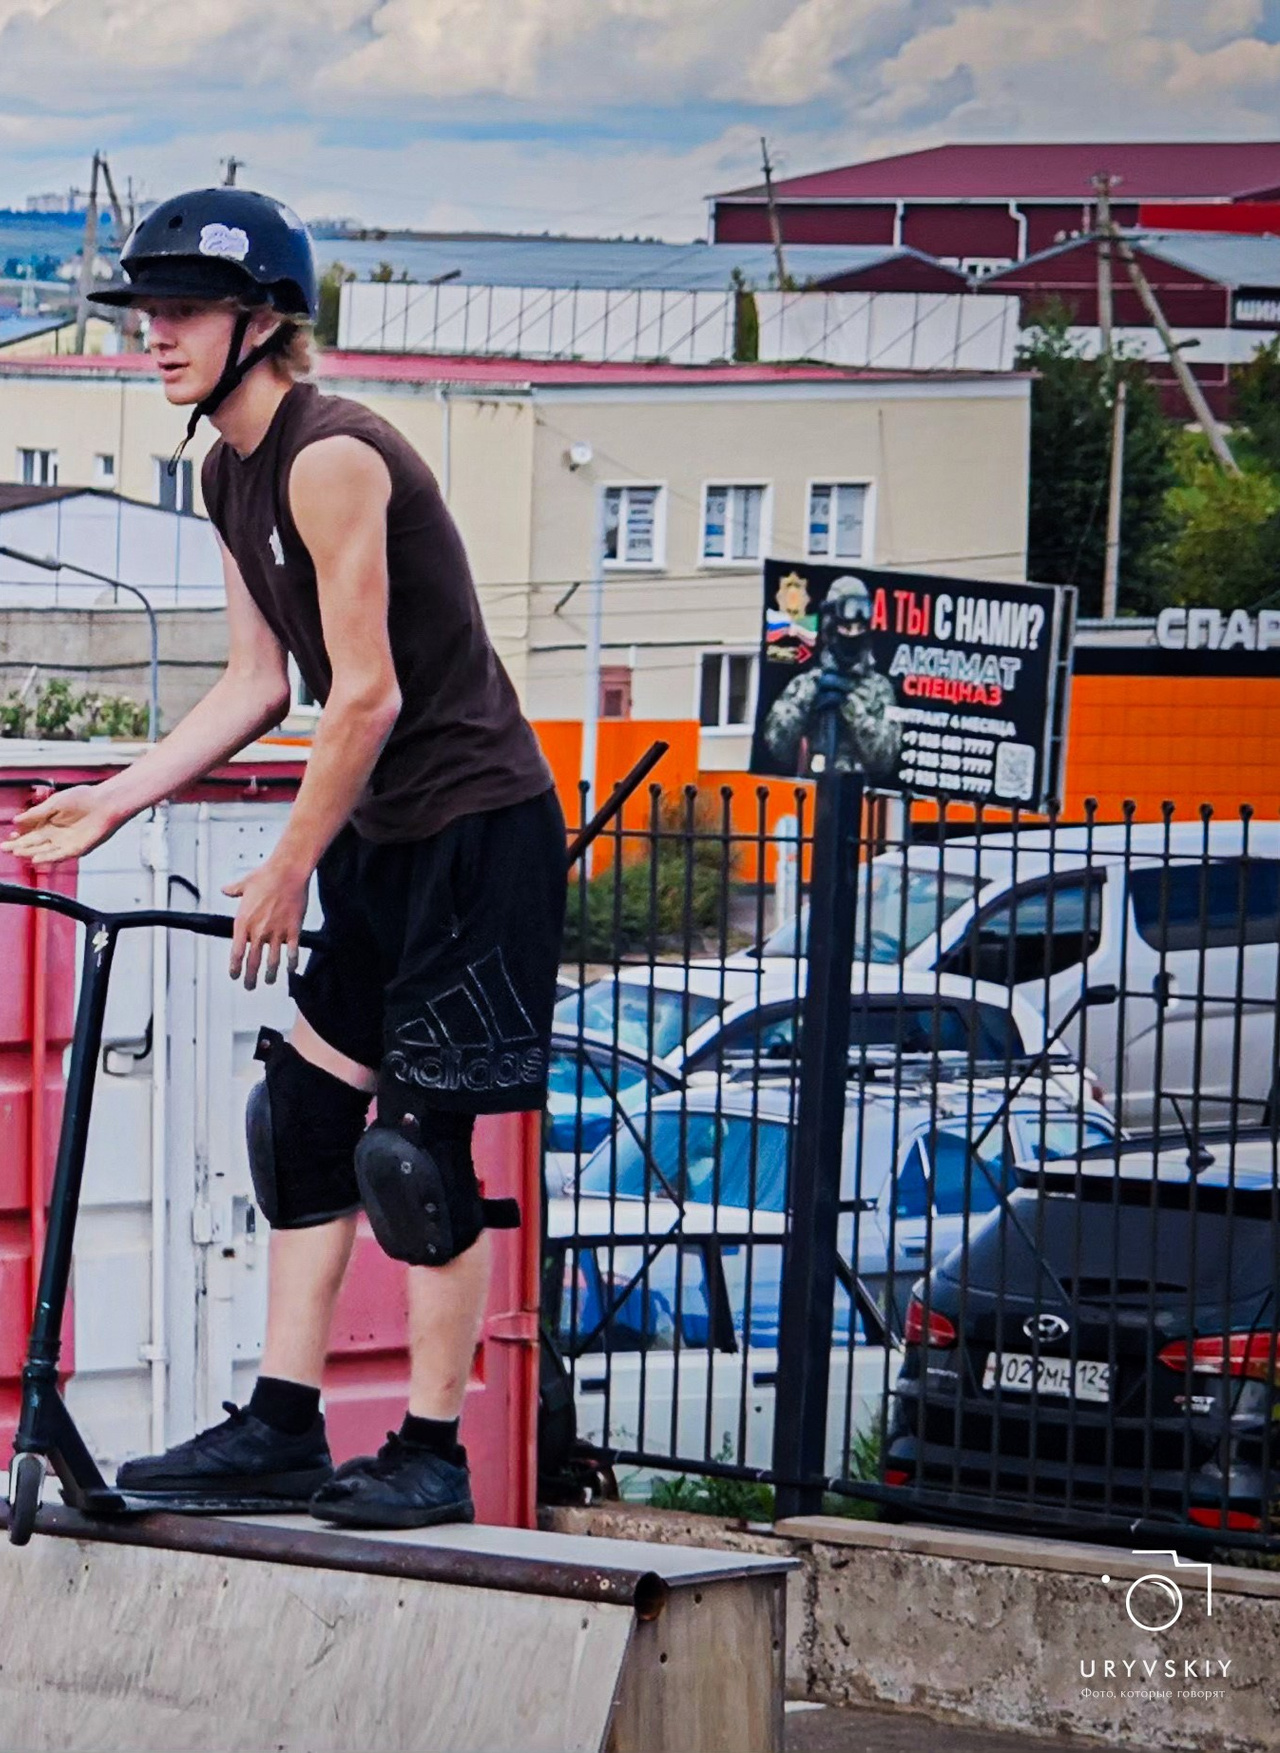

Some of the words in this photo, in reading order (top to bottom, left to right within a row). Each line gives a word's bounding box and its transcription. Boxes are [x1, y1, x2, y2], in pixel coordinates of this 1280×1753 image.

[871, 588, 888, 632] А
[894, 590, 930, 636] ТЫ
[934, 594, 953, 640] С
[955, 596, 1045, 650] НАМИ?
[903, 674, 1002, 706] СПЕЦНАЗ
